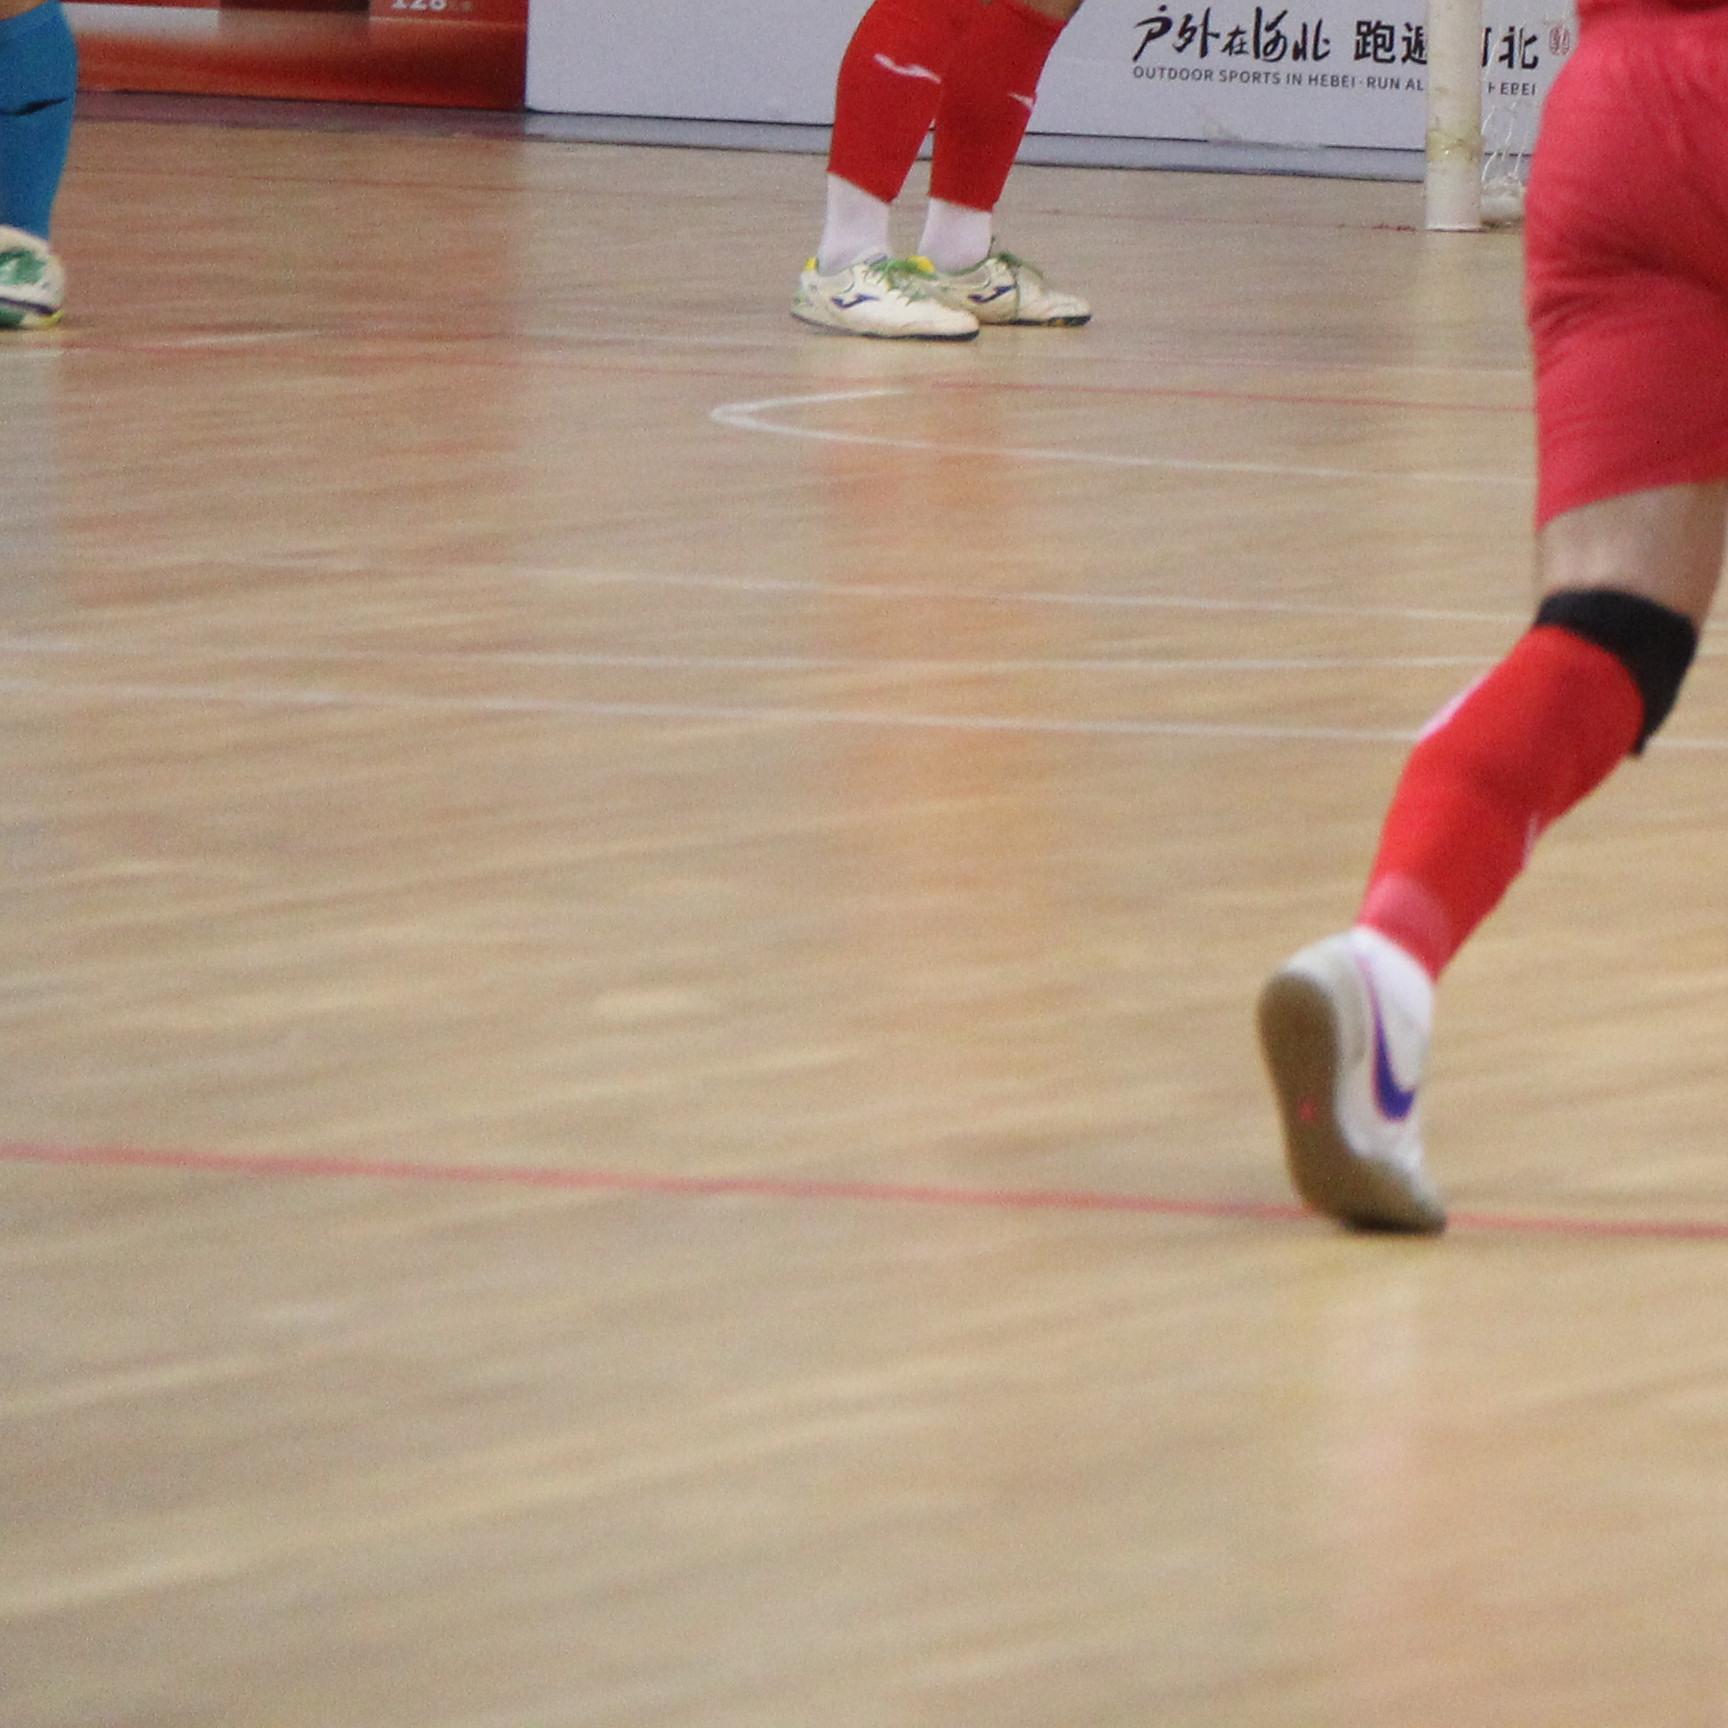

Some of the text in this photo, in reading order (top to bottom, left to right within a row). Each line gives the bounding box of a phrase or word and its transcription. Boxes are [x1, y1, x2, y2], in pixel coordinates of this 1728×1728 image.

[1132, 65, 1214, 82] OUTDOOR
[1218, 69, 1281, 85] SPORTS
[1286, 73, 1302, 86] IN
[1366, 75, 1400, 90] RUN
